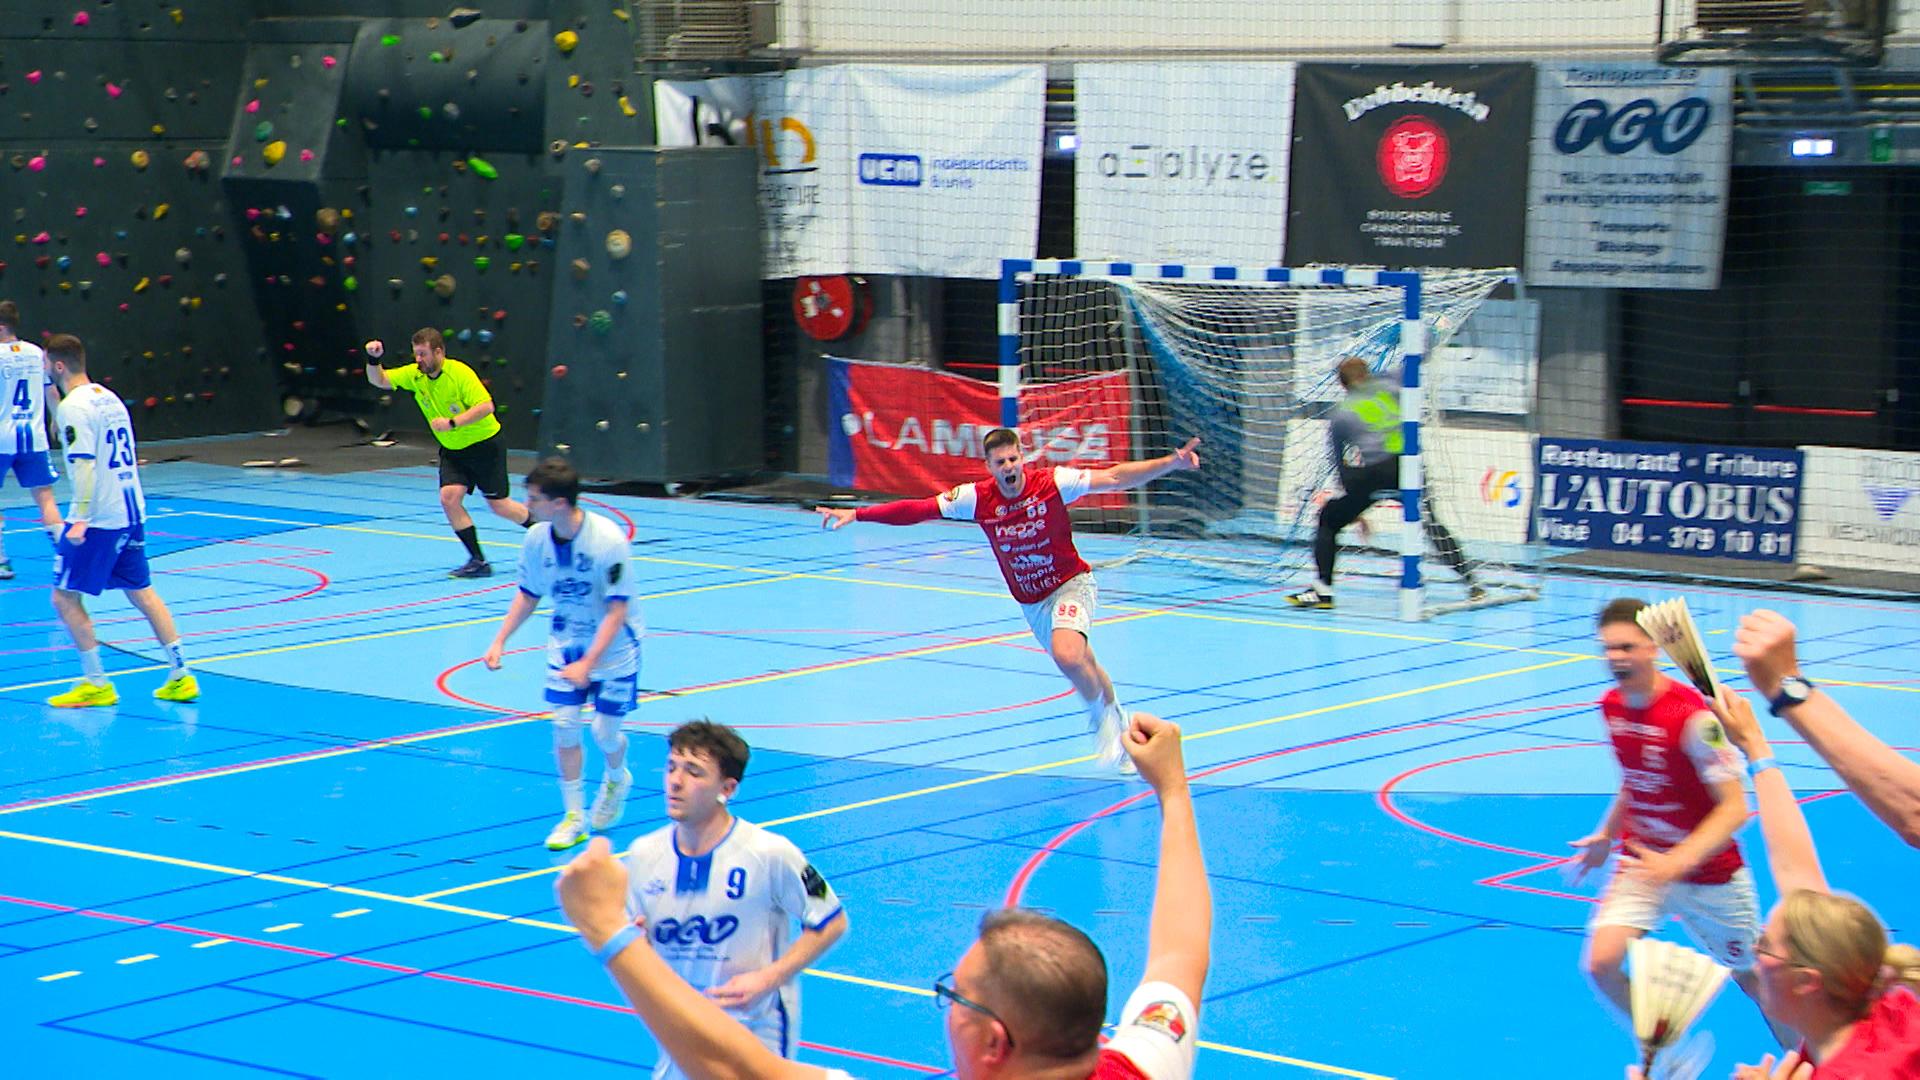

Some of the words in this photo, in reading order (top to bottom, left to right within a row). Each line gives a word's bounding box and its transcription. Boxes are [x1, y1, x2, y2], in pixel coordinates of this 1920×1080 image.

[1555, 97, 1711, 155] TGV
[13, 379, 32, 411] 4
[106, 427, 134, 469] 23
[1541, 445, 1681, 473] Restaurant
[1705, 453, 1798, 479] Friture
[1539, 473, 1796, 526] L'AUTOBUS
[1537, 517, 1591, 542] Visé
[1611, 523, 1644, 546] 04
[1667, 526, 1716, 552] 379
[1721, 530, 1755, 554] 10
[1759, 532, 1792, 557] 81
[726, 867, 746, 900] 9
[654, 915, 739, 945] TGV
